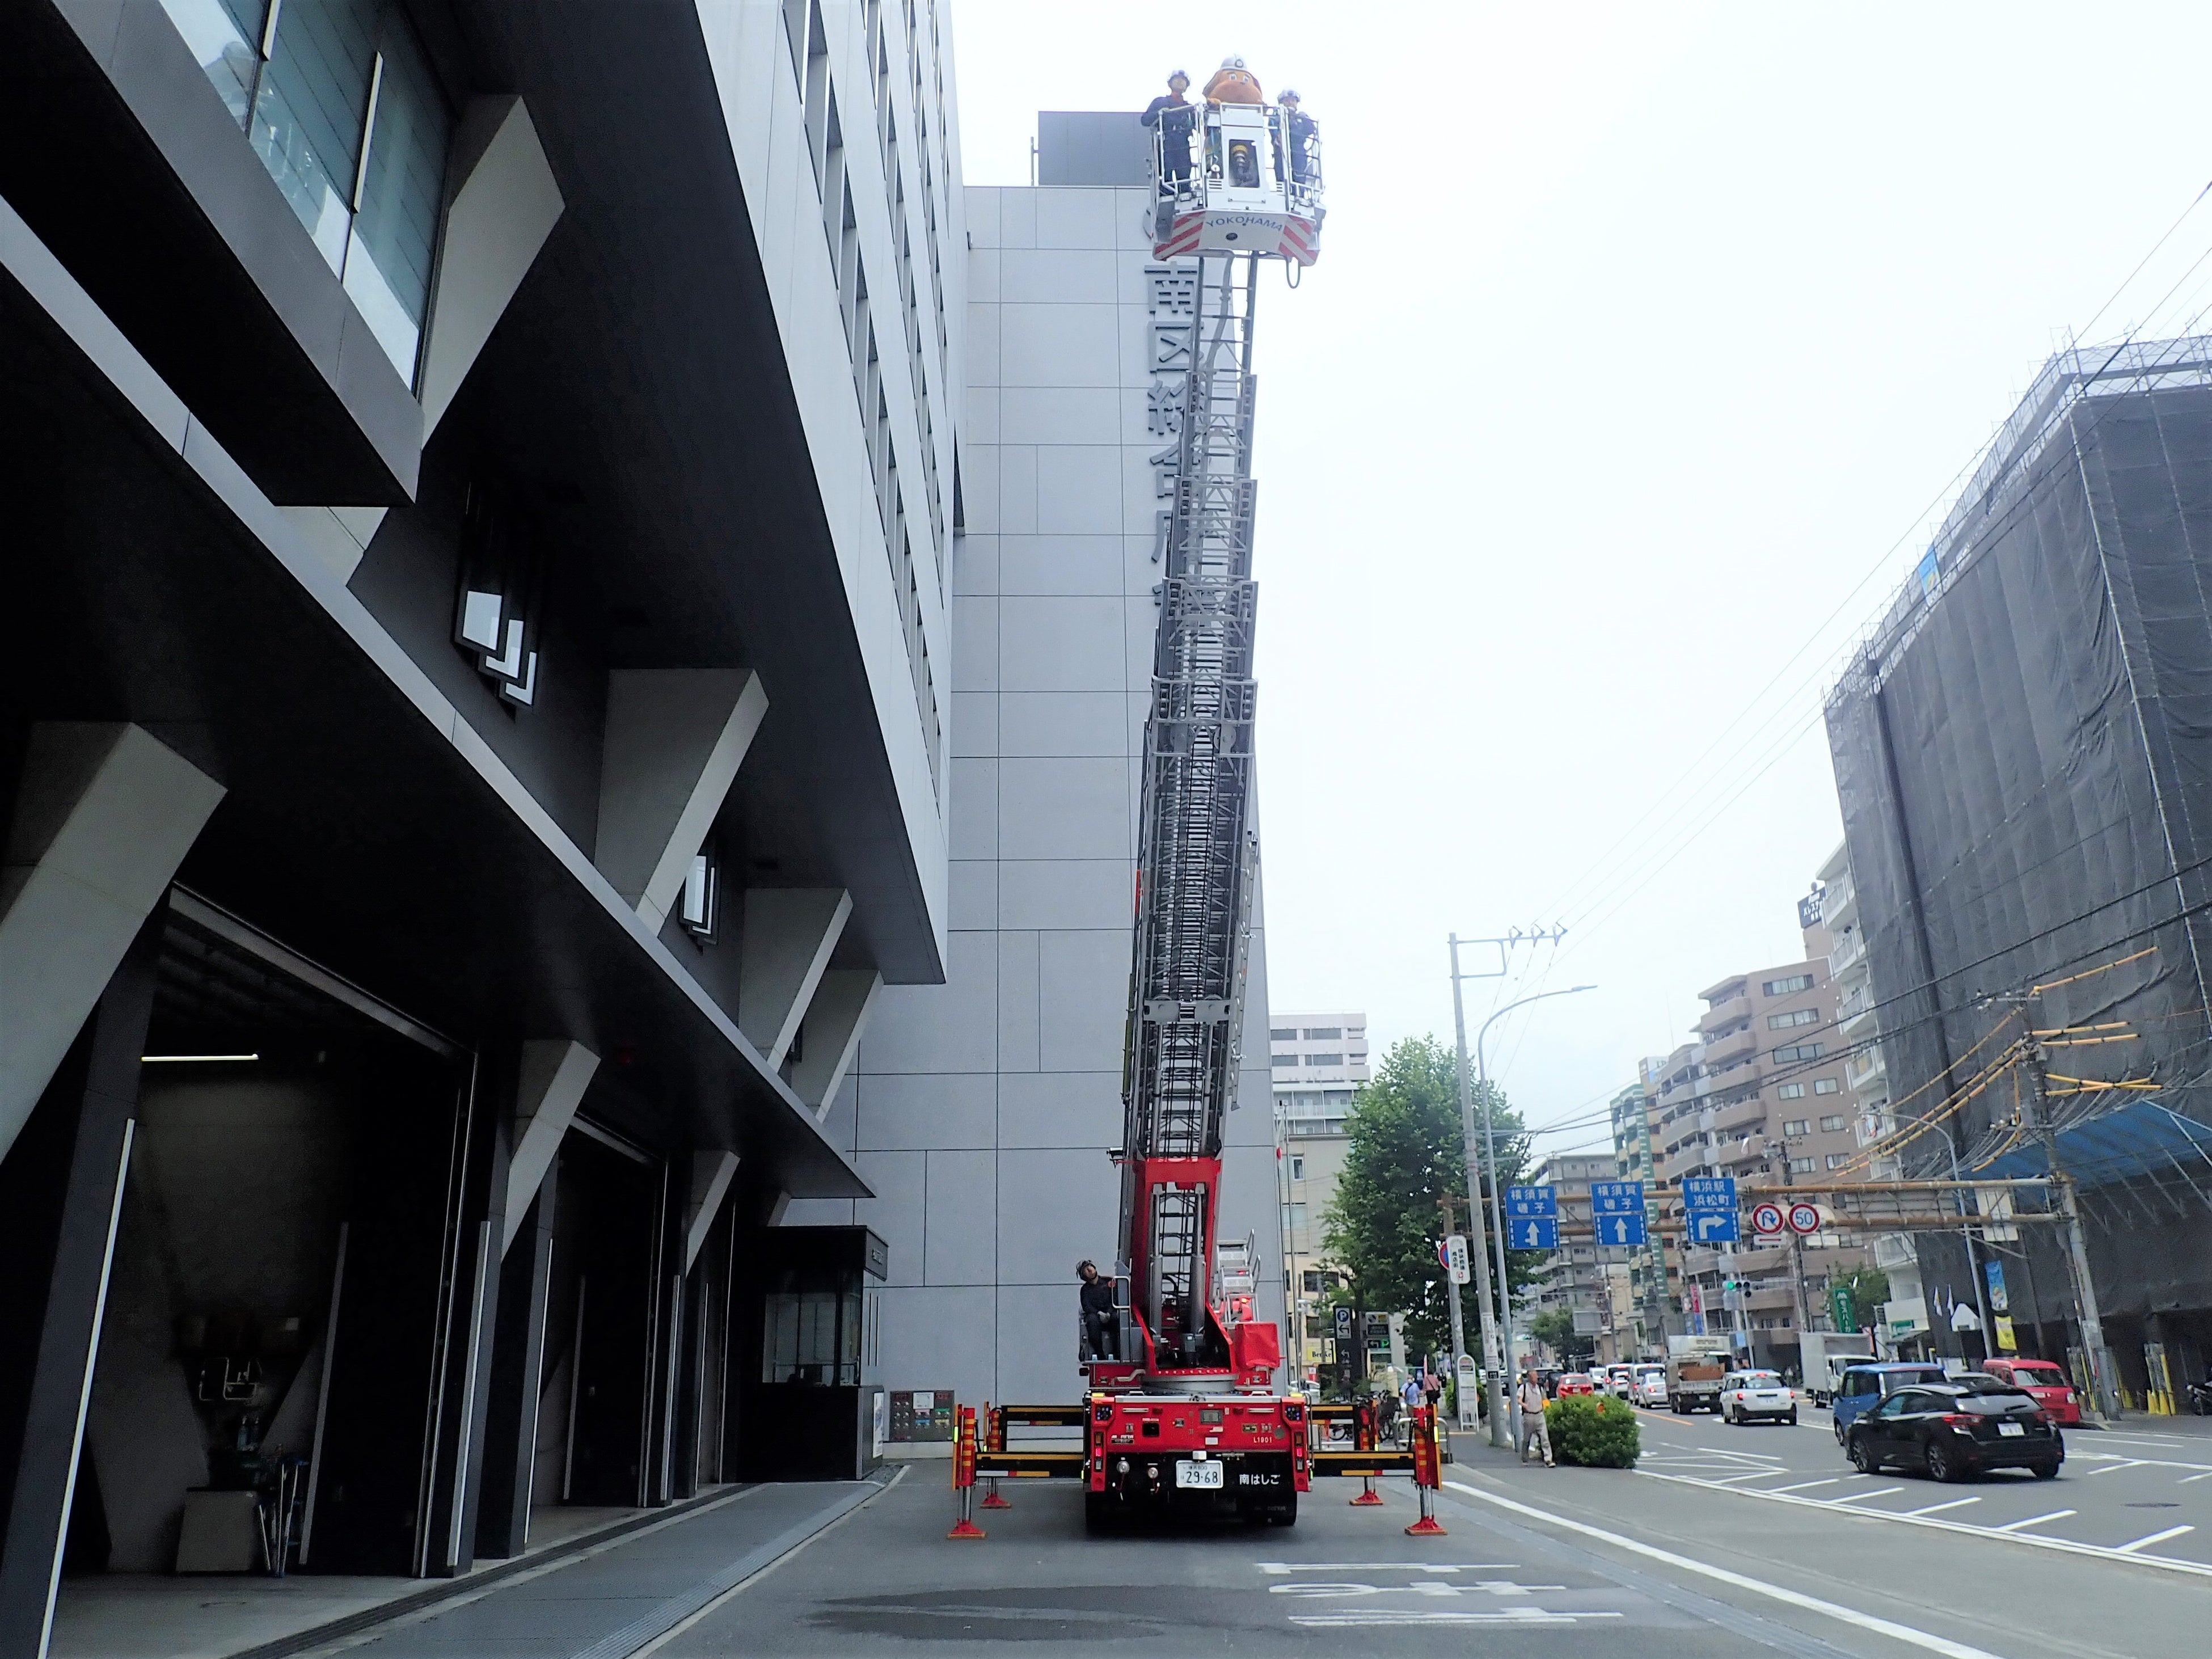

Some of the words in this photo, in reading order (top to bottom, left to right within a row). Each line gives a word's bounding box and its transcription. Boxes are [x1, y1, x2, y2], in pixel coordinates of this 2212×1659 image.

[1205, 216, 1283, 231] YOKOHAMA
[1598, 1184, 1636, 1197] 横須賀
[1689, 1180, 1725, 1193] 横浜駅
[1510, 1189, 1549, 1201] 横須賀
[1694, 1194, 1729, 1206] 浜松町
[1795, 1211, 1813, 1225] 50
[1381, 1339, 1389, 1348] P
[1239, 1474, 1281, 1485] 南はしご
